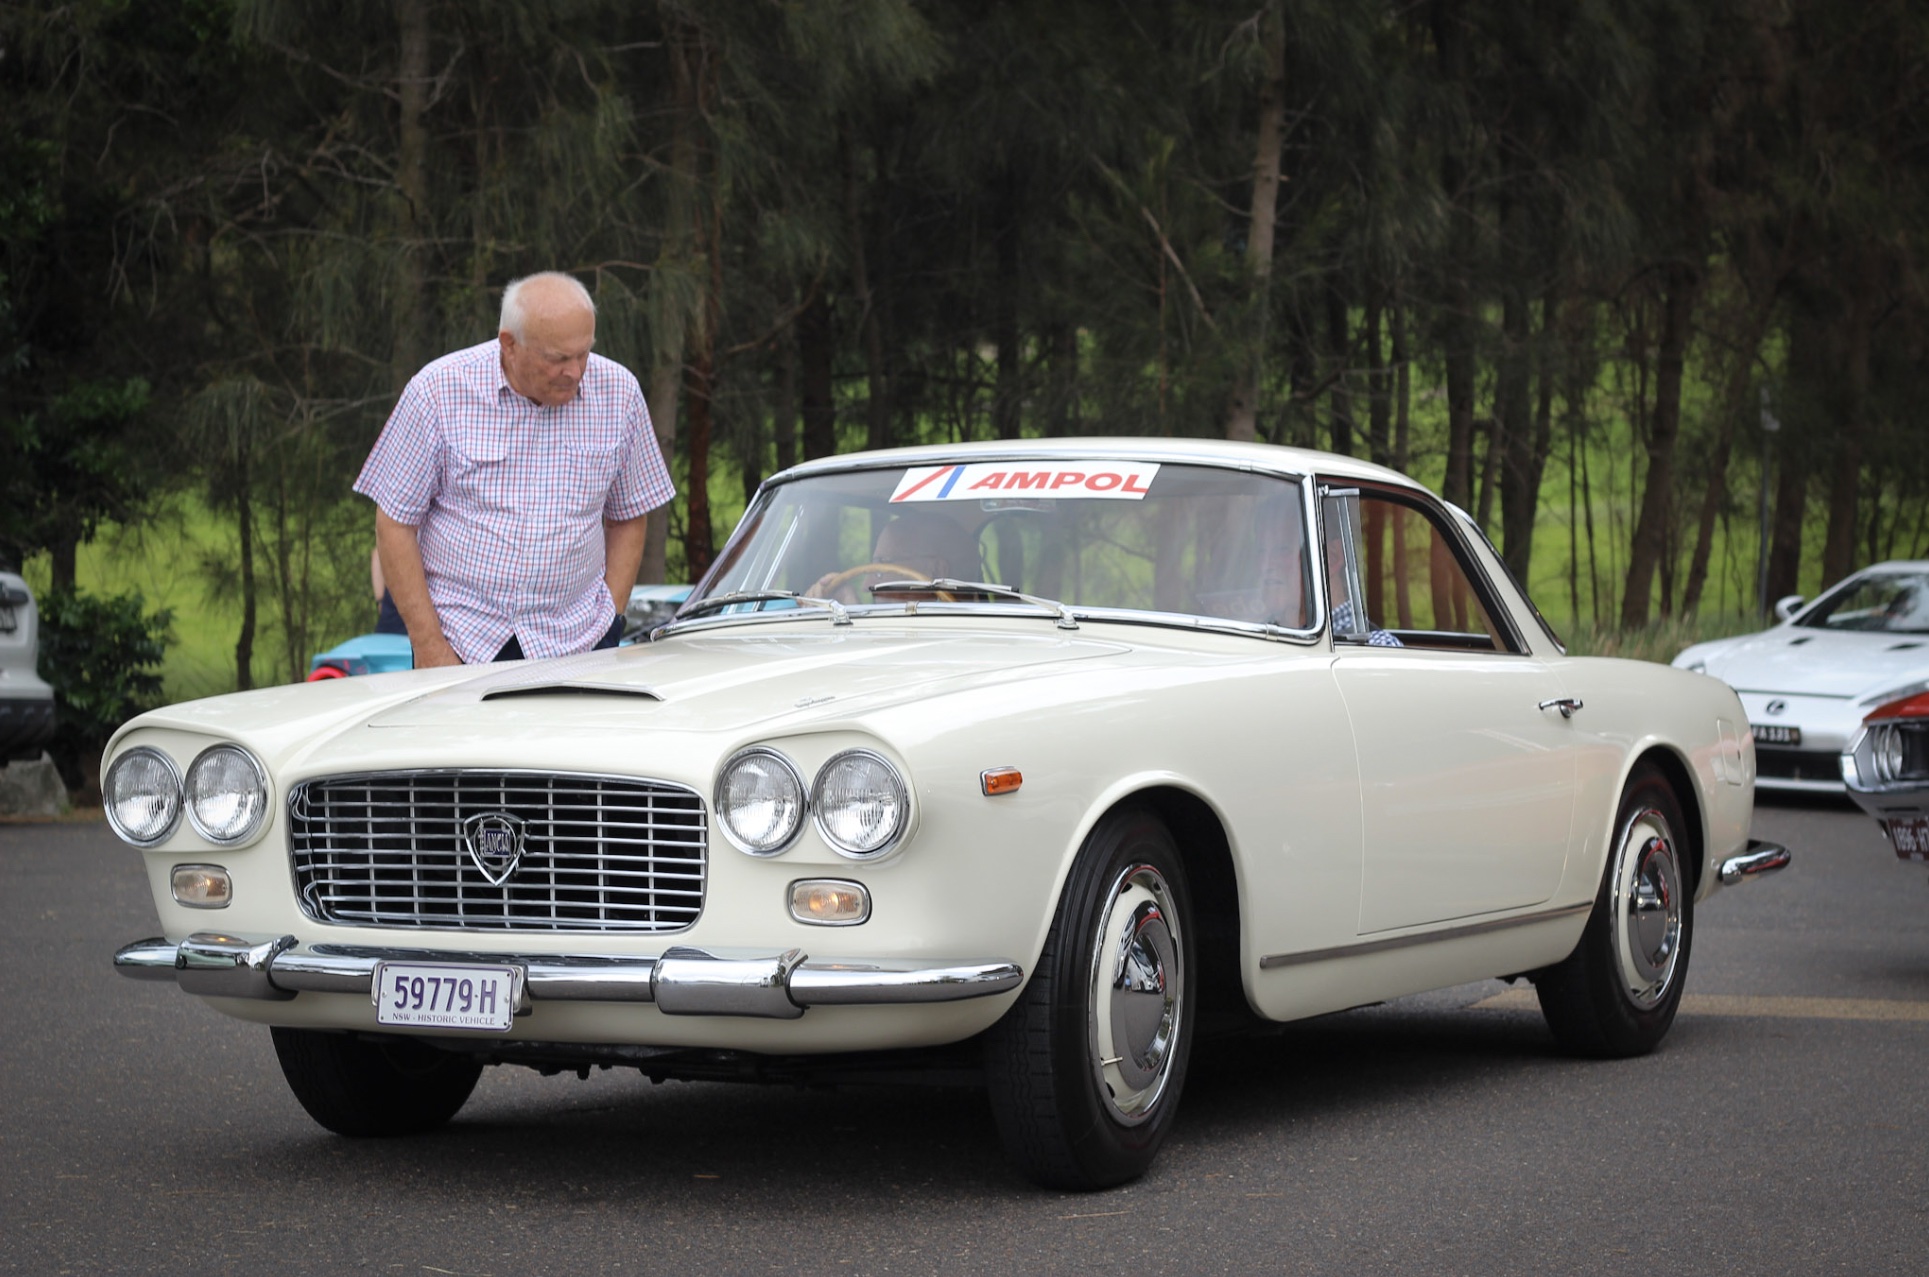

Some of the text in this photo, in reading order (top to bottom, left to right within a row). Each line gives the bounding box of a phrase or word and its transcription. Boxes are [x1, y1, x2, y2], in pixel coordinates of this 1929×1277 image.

[967, 472, 1148, 493] AMPOL
[392, 1013, 411, 1021] NSW
[417, 1014, 457, 1024] HISTORIC
[459, 1016, 496, 1026] VEHICLE
